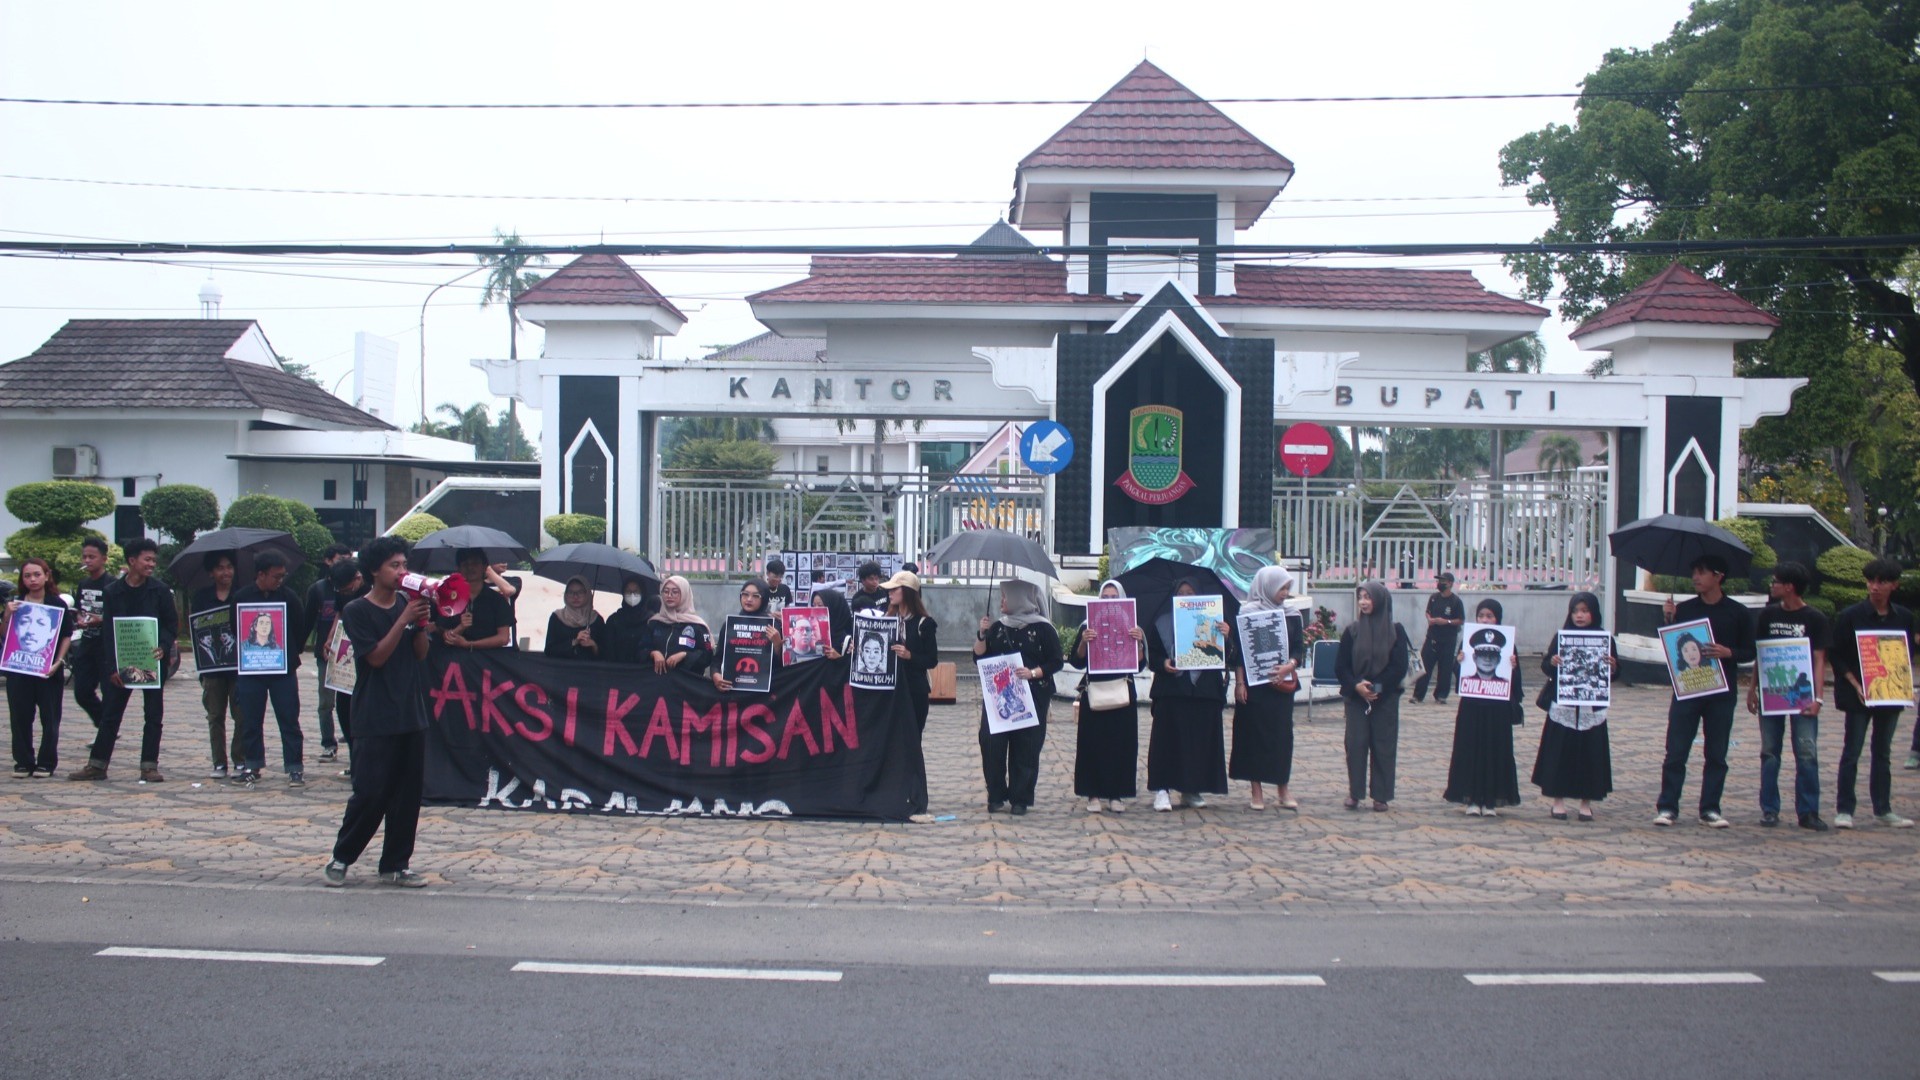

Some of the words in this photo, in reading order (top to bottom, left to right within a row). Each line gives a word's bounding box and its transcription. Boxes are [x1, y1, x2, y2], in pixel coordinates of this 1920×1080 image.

[729, 376, 953, 401] KANTOR
[1335, 385, 1556, 411] BUPATI
[1122, 479, 1148, 500] PANGKAL
[1149, 480, 1187, 502] PERJUANGAN
[1179, 601, 1216, 609] SOEHARTO
[733, 623, 748, 631] KRITIK
[736, 631, 752, 639] TEROR,
[8, 651, 46, 667] MUNIR
[1461, 678, 1509, 696] CIVILPHOBIA
[430, 661, 579, 747] AKSI
[602, 684, 860, 768] KAMISAN
